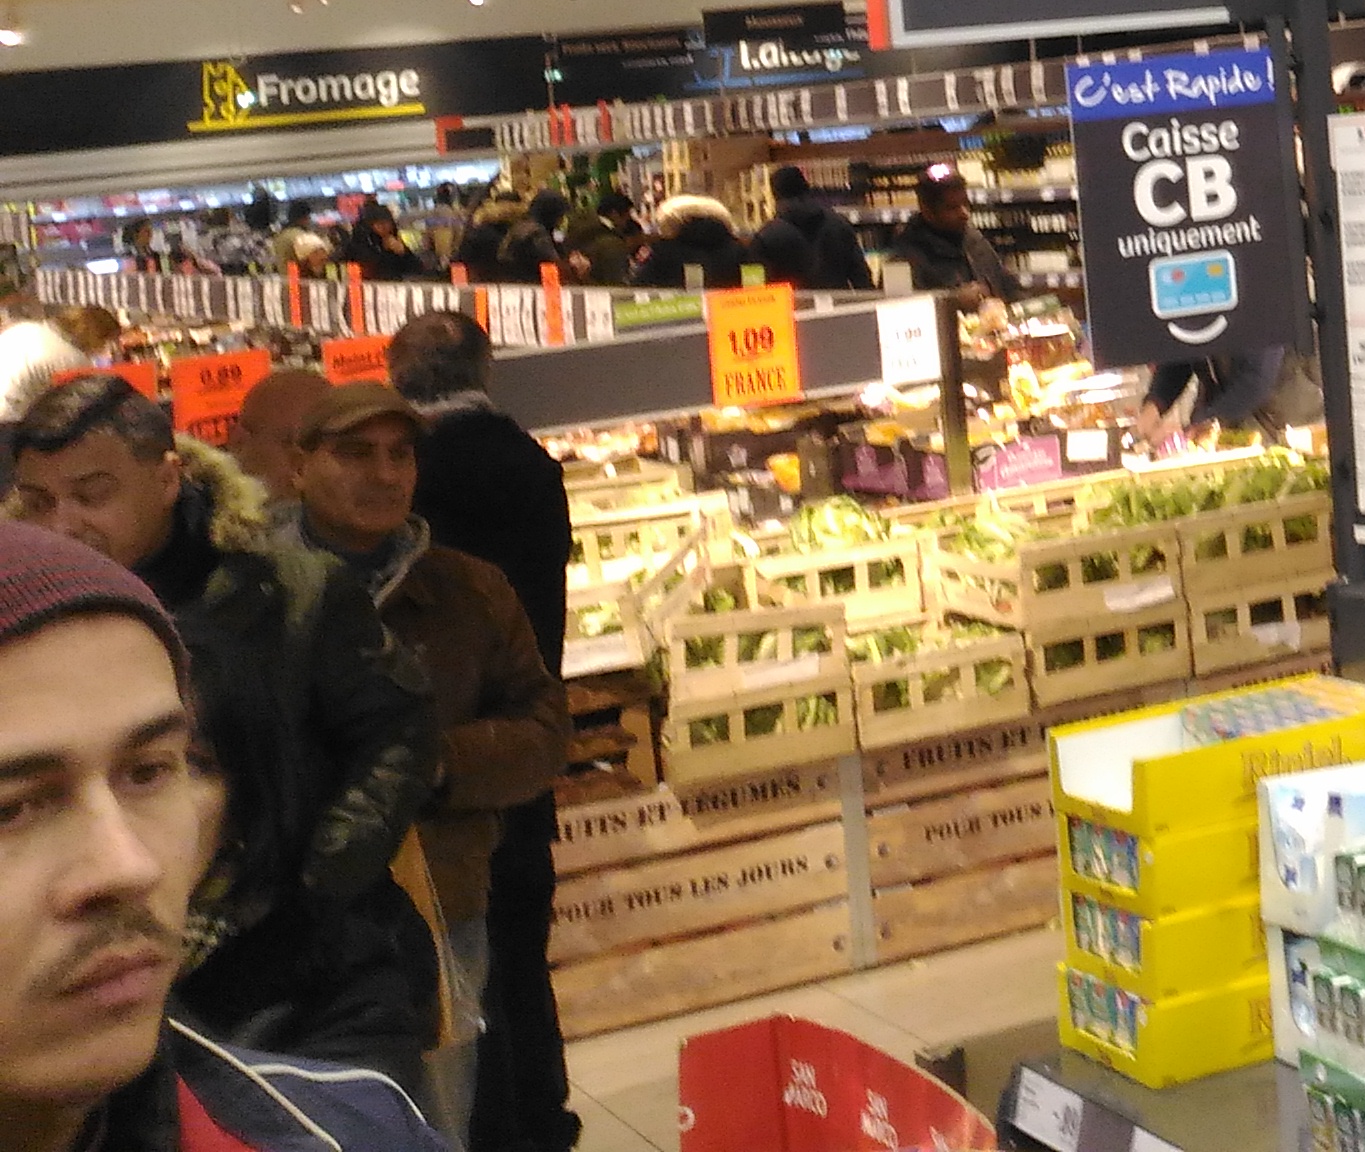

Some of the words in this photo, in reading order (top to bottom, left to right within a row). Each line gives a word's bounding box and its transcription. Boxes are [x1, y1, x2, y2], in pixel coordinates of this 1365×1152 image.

[256, 68, 421, 108] Fromage
[1121, 117, 1240, 163] Caisse
[1133, 154, 1238, 228] CB
[1117, 214, 1263, 259] uniquement
[724, 366, 788, 397] FRANCE
